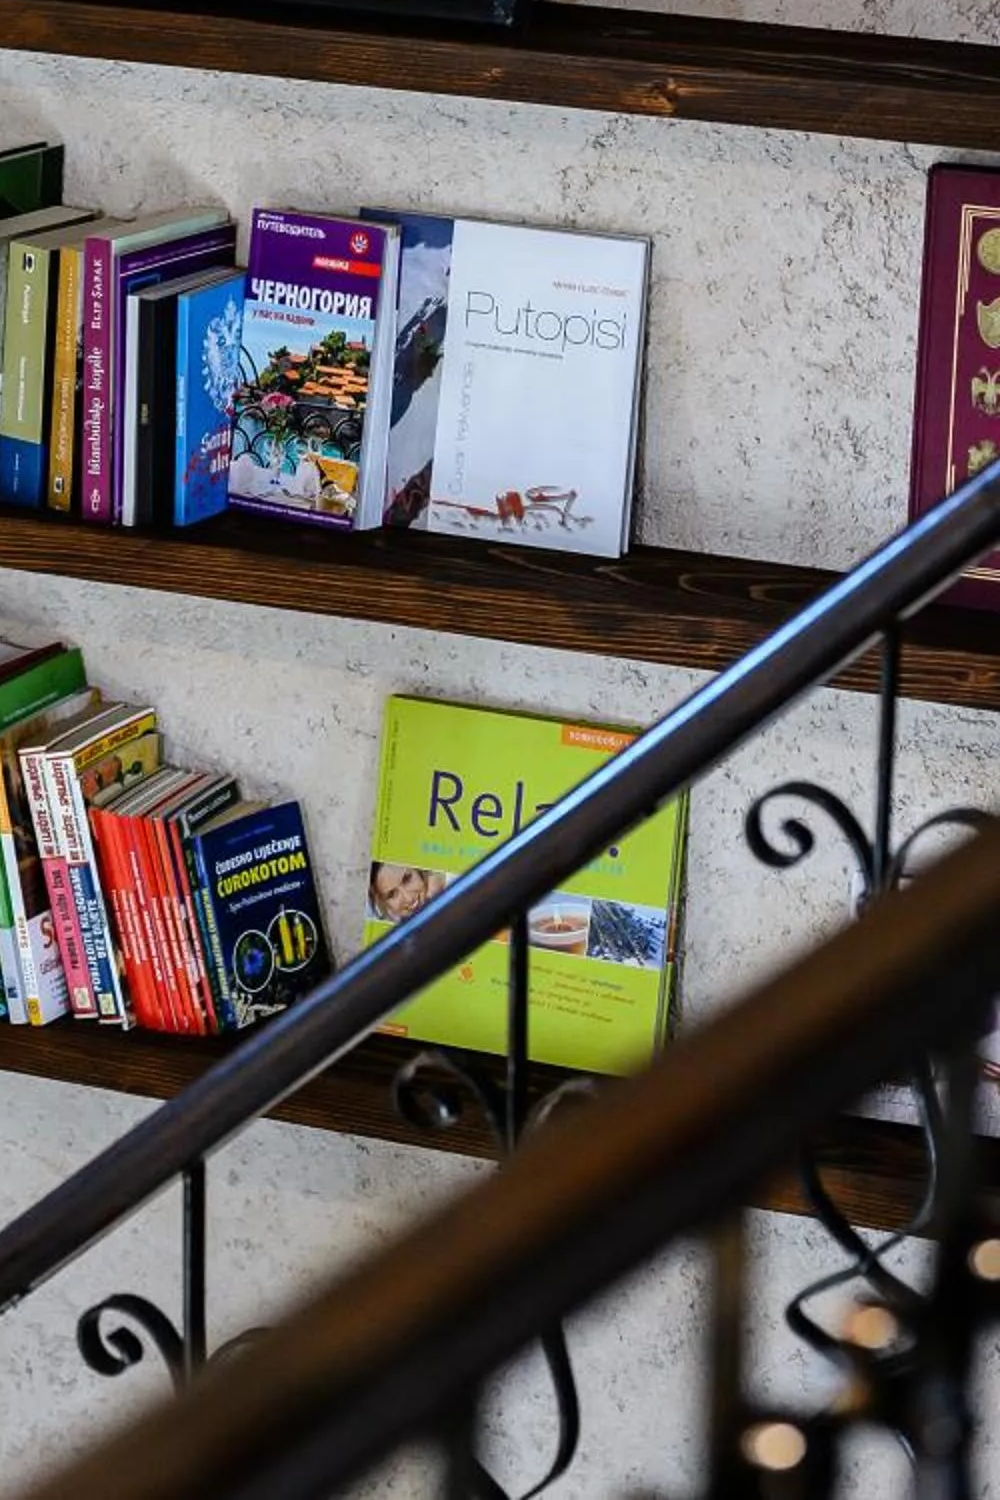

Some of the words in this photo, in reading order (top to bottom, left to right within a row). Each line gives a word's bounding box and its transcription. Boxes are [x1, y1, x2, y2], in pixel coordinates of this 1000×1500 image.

[251, 278, 373, 321] ЧЕРНОГОРИЯ
[465, 291, 627, 353] Putopisi
[85, 347, 104, 390] kopile
[217, 852, 307, 898] ĆUROKOTOM
[81, 930, 102, 992] POBIJEDITE
